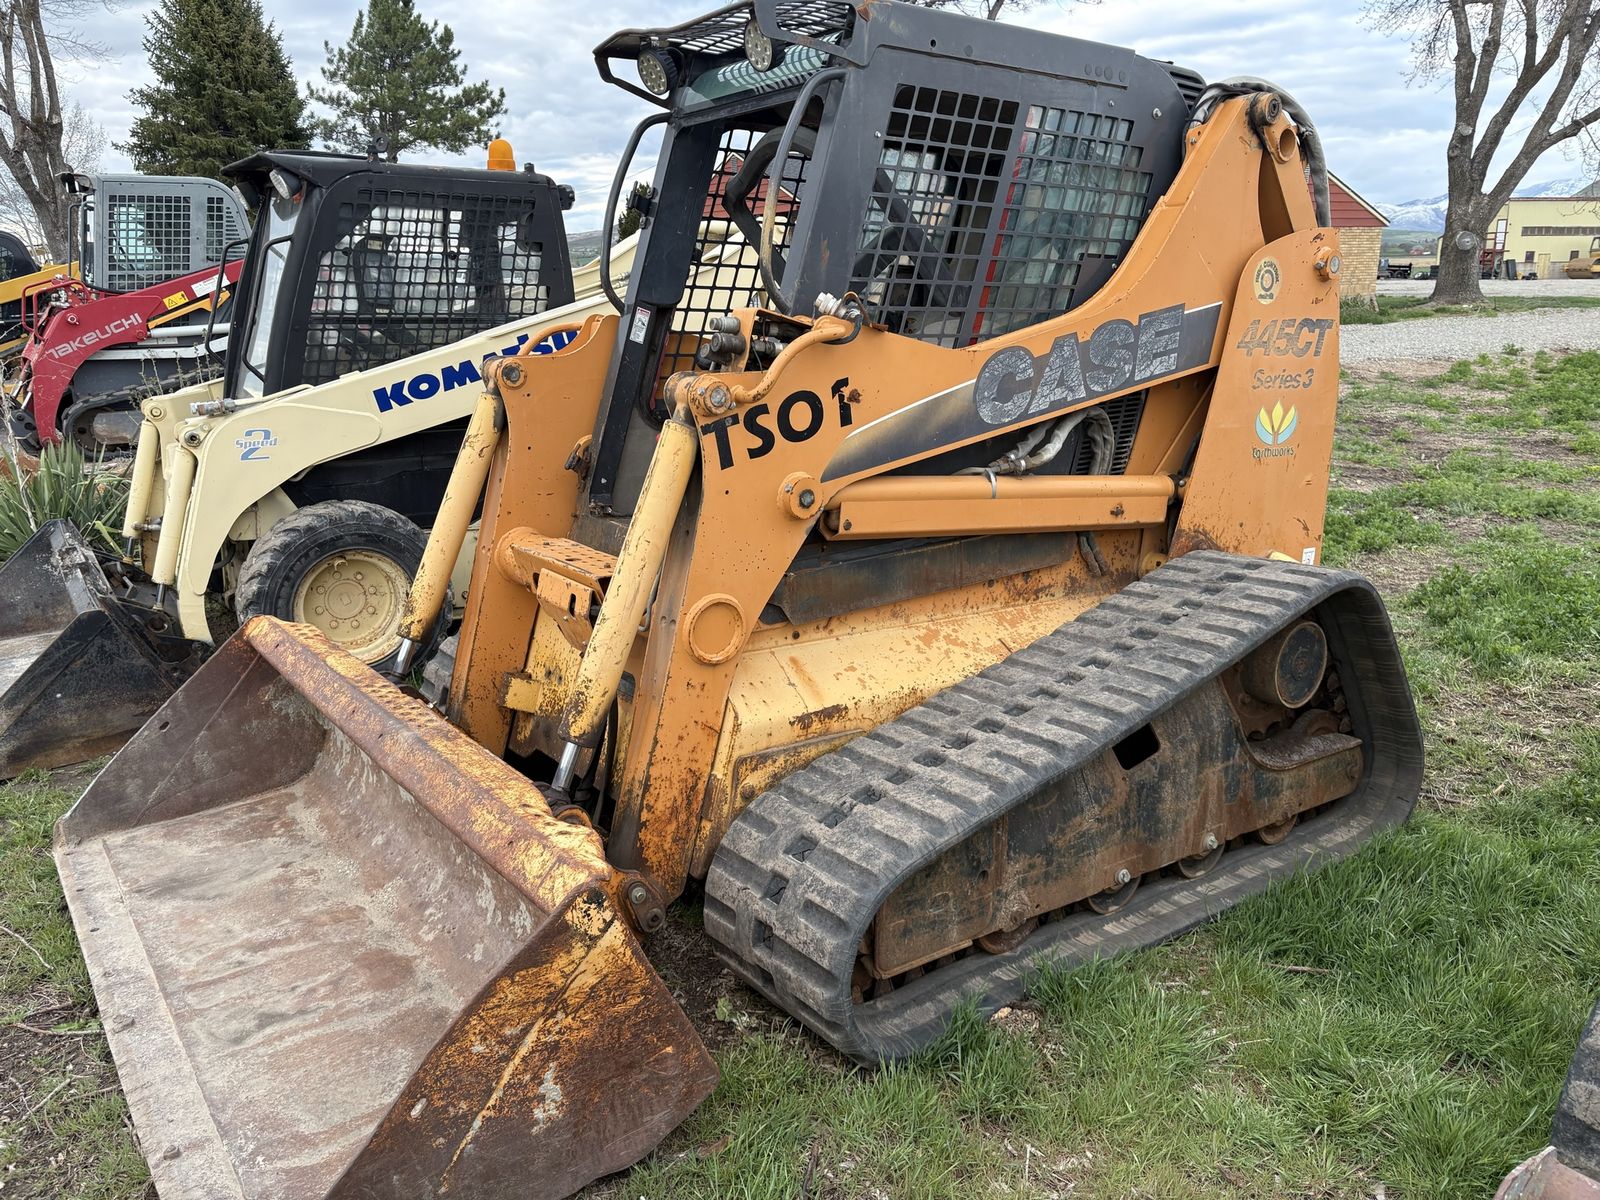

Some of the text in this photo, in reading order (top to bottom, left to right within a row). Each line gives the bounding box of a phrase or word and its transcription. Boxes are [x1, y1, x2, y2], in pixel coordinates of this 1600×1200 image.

[1236, 318, 1334, 358] 445CT
[372, 331, 578, 413] KOMTSU
[976, 307, 1184, 425] CASE
[1251, 368, 1315, 390] Series 3
[235, 429, 278, 461] 2 Speed
[1252, 446, 1295, 459] Earthworks
